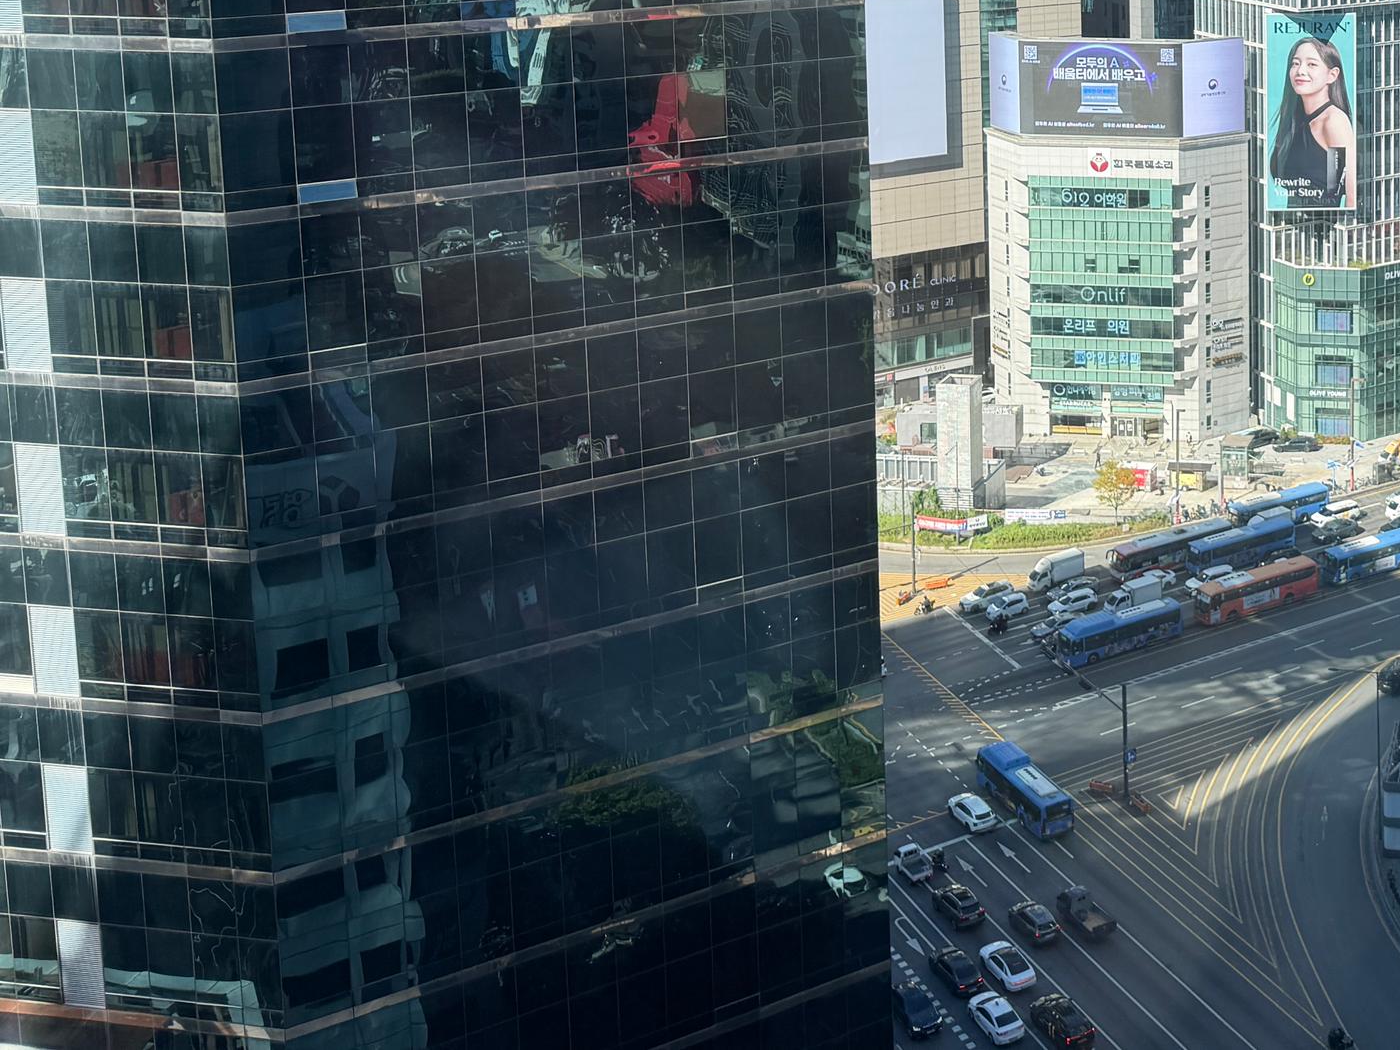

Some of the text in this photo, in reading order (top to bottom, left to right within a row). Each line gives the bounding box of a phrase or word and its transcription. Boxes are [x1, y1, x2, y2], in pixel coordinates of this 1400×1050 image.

[1274, 21, 1347, 34] REJURAN
[1053, 67, 1146, 82] 배움터에서 배우고
[1274, 177, 1311, 187] Rewrite
[1094, 191, 1127, 208] 어학원
[1274, 188, 1324, 199] Your Story
[1080, 286, 1126, 302] Onlif
[1063, 318, 1130, 335] 온리프 의원
